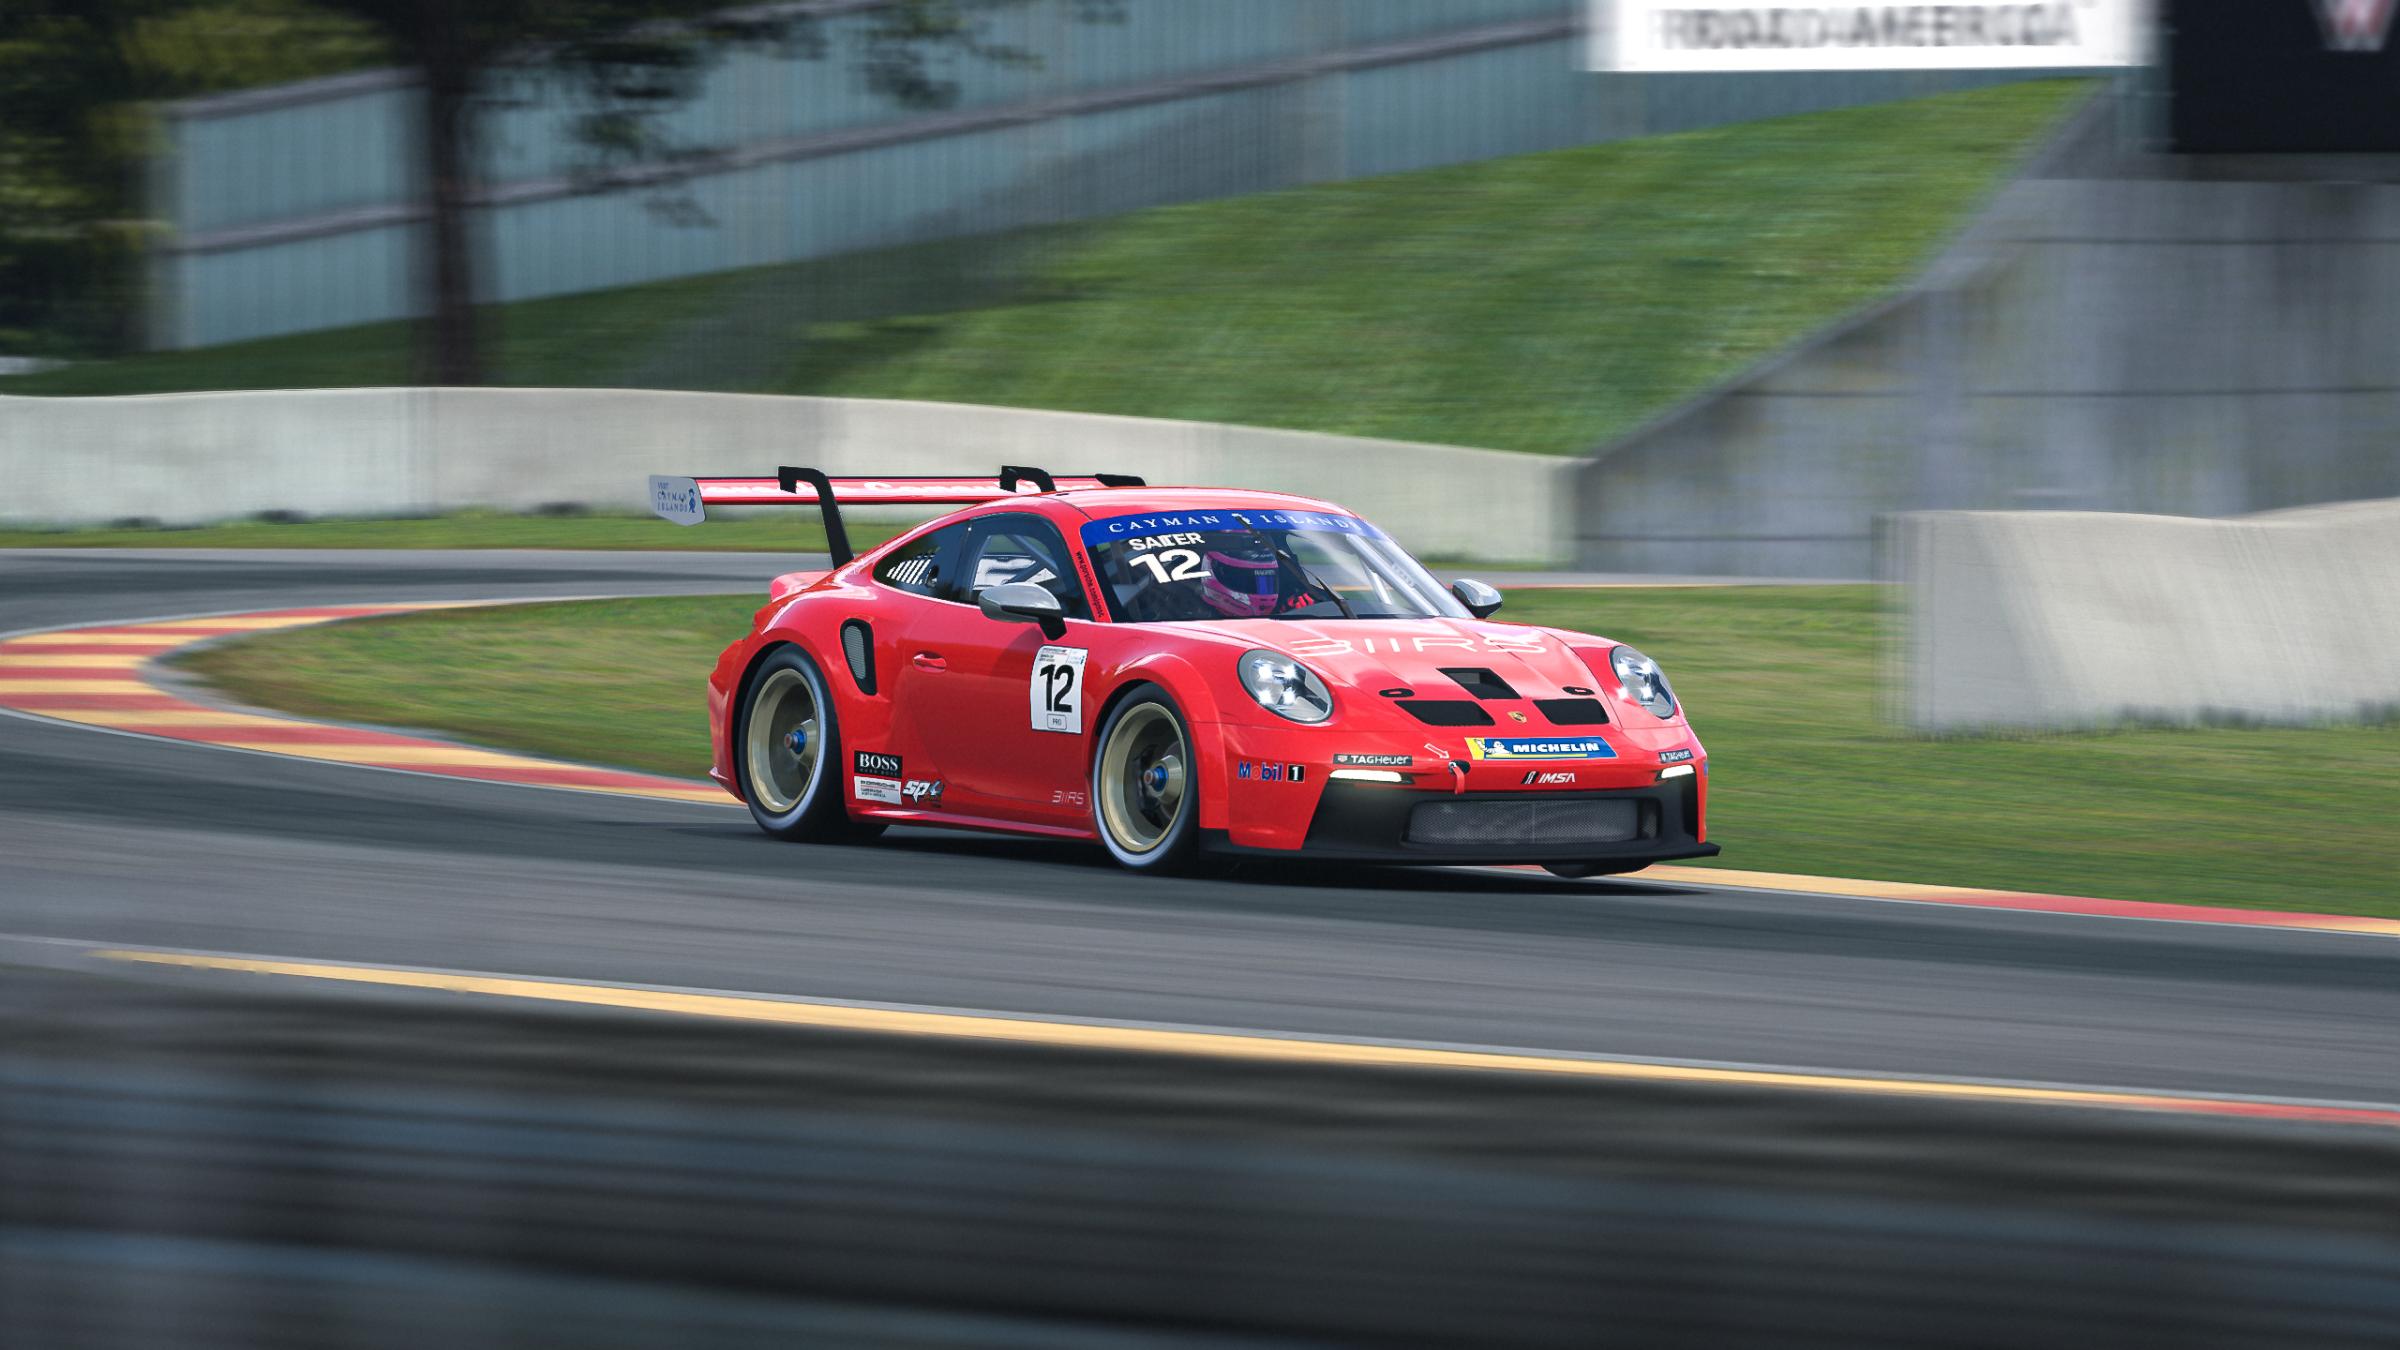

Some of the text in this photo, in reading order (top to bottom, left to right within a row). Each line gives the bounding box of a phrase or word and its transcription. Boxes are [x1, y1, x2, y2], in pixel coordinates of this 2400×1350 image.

[1108, 515, 1220, 533] CAYMAN
[1128, 548, 1212, 584] 12
[1040, 664, 1074, 713] 12
[1513, 742, 1600, 753] MICHELIN
[859, 753, 898, 771] BOSS
[1237, 761, 1283, 781] Mobil
[1537, 772, 1576, 784] IMSA
